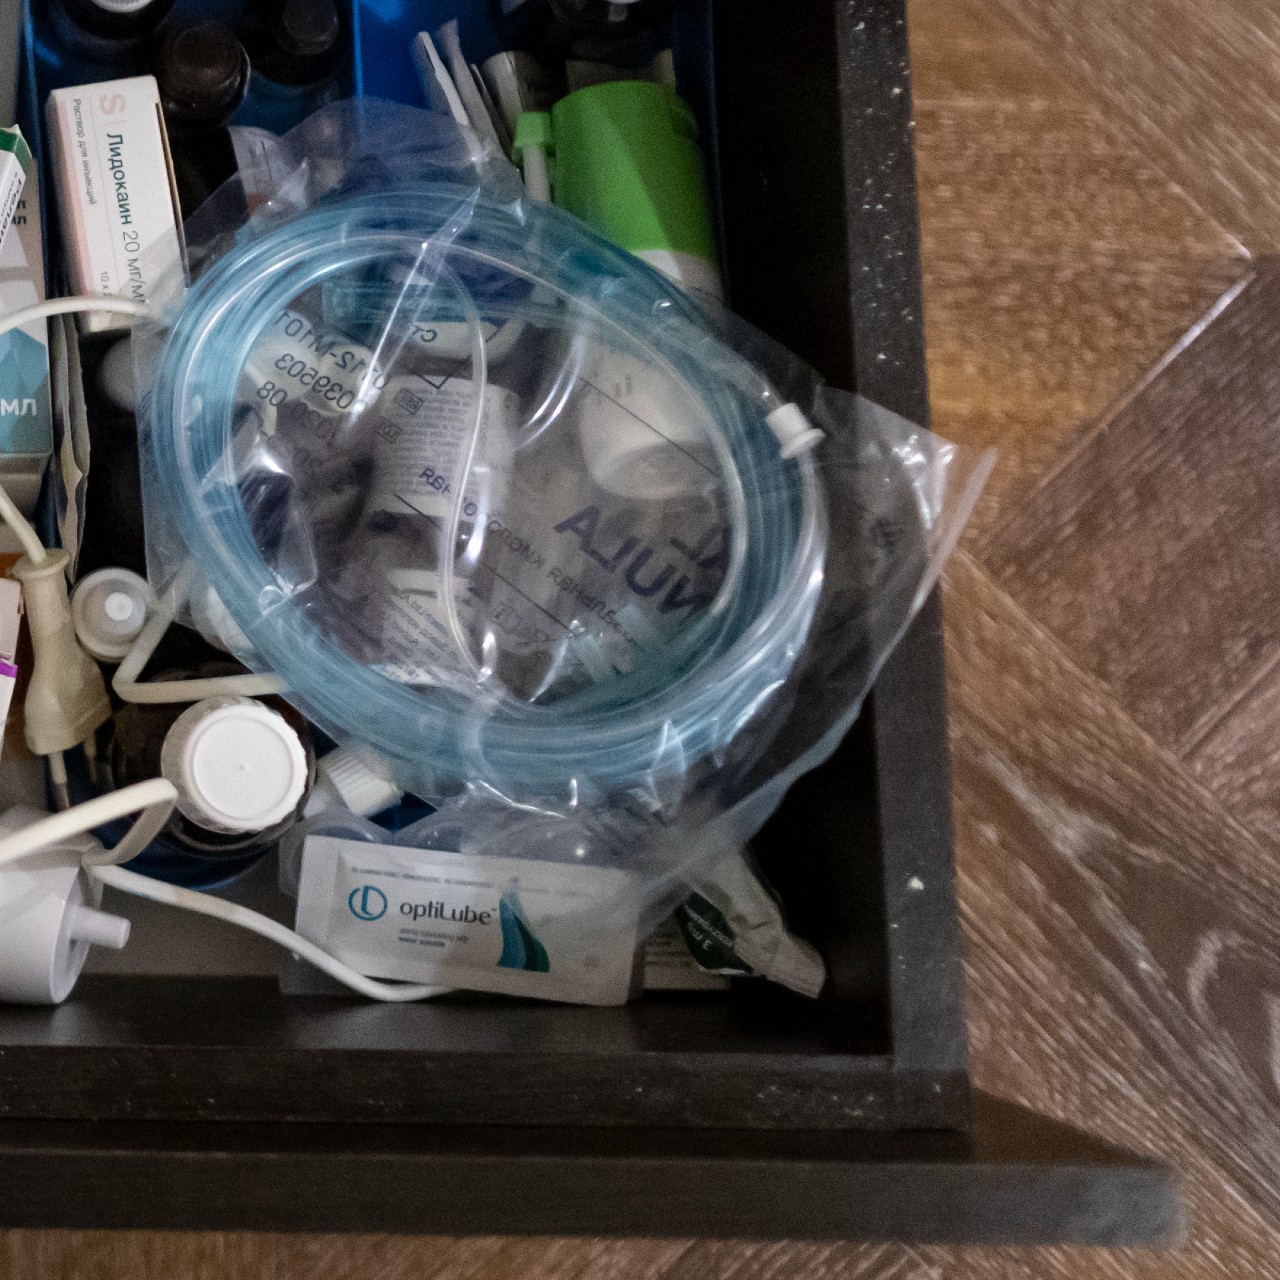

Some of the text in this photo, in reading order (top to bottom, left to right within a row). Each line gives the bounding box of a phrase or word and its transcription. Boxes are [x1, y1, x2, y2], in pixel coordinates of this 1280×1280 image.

[70, 98, 99, 206] Раствор для инъекций
[103, 131, 141, 254] Лидокаин 20
